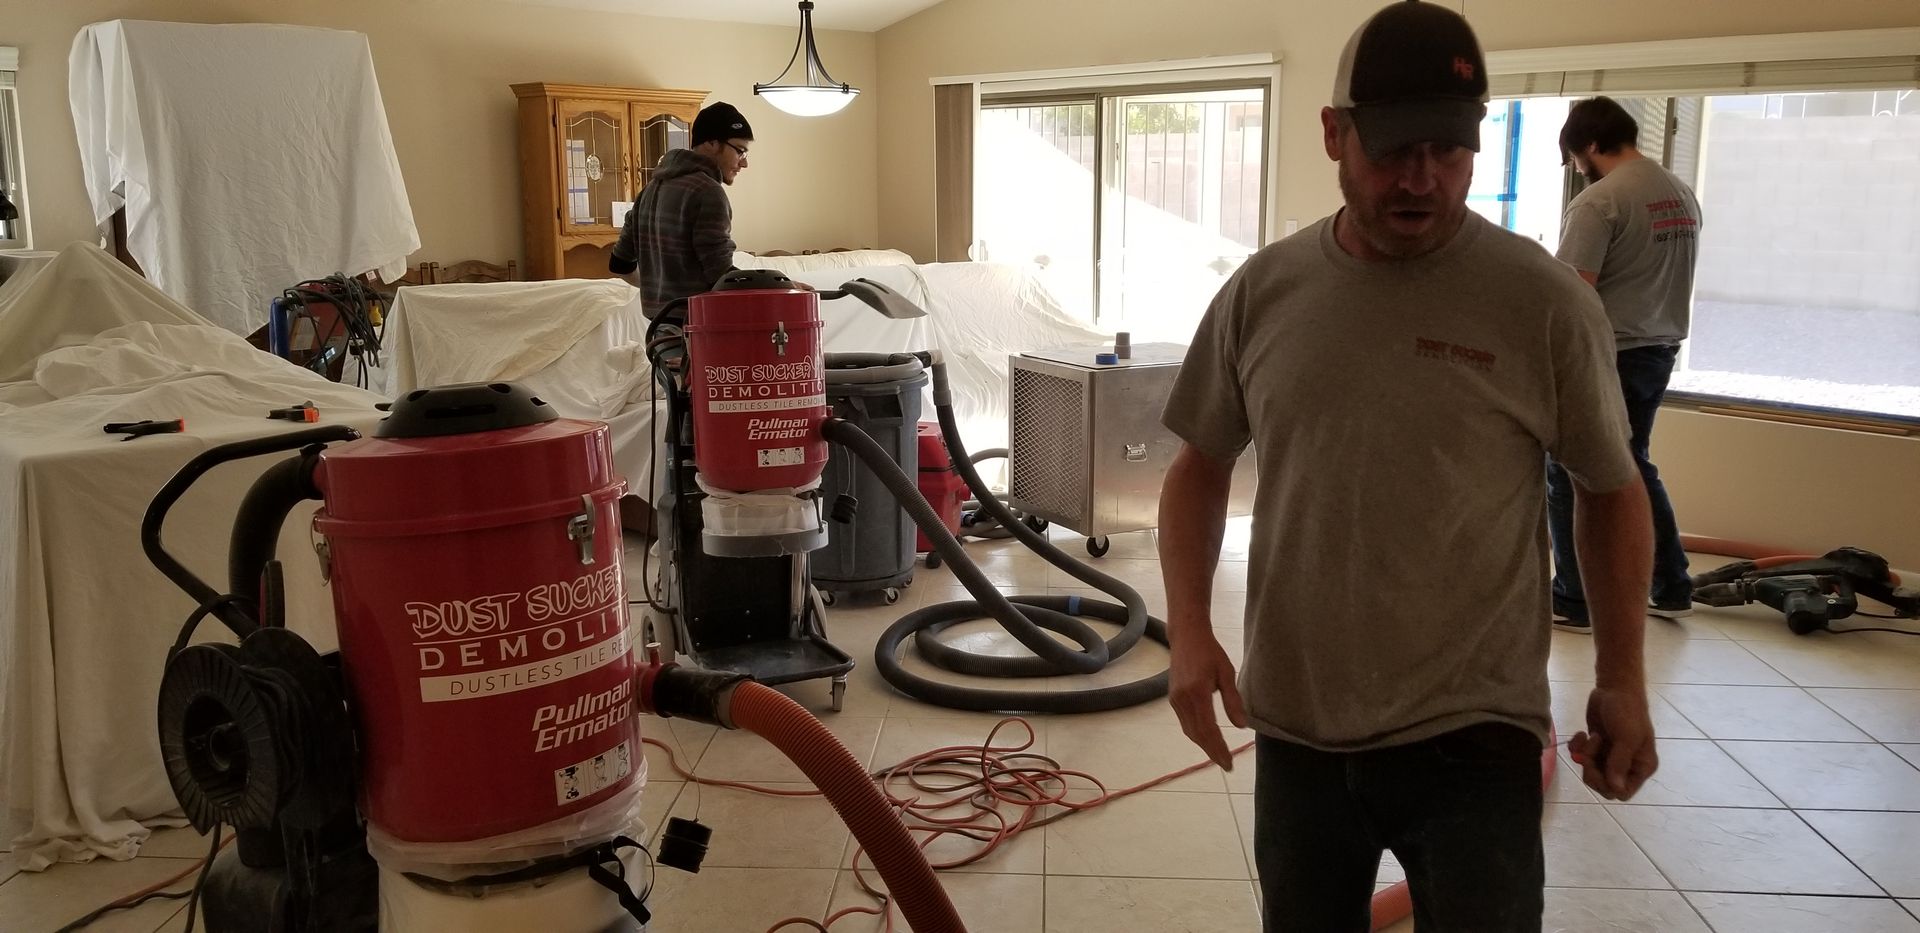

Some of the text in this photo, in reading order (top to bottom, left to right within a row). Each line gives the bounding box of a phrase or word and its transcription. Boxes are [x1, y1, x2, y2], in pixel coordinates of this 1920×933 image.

[705, 356, 813, 384] DUST SUCKER
[718, 402, 769, 412] DUSTLESS
[773, 400, 794, 409] TILE
[747, 417, 809, 430] Pullman
[747, 427, 810, 441] Ermator
[404, 592, 521, 639] DUST
[450, 661, 563, 696] DUSTLESS
[573, 646, 606, 672] TILE
[531, 678, 631, 732] Pullman
[534, 697, 633, 753] Ermator
